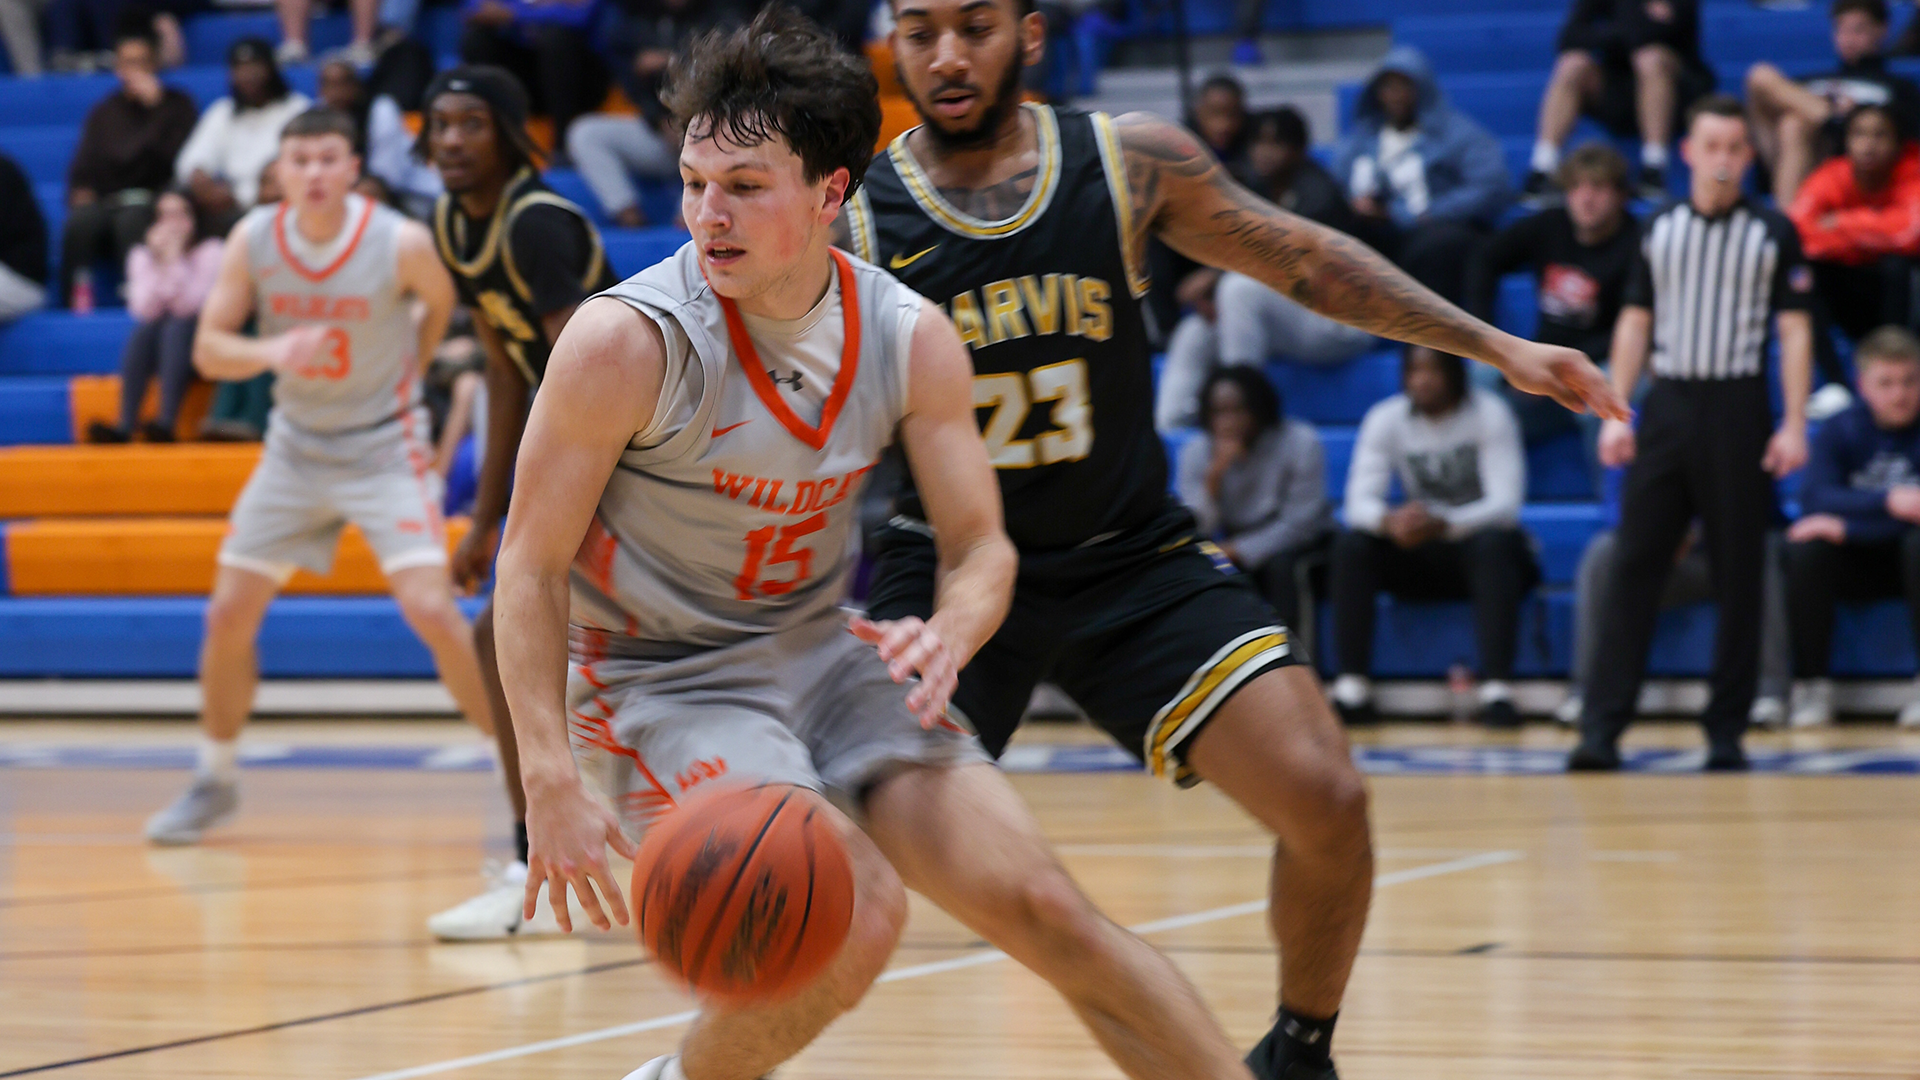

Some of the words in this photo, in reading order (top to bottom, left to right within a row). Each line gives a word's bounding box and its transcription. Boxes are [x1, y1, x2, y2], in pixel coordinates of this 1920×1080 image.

[936, 273, 1113, 350] ARVIS
[972, 357, 1095, 469] 23
[712, 456, 881, 516] WILDCA
[733, 511, 828, 600] 15
